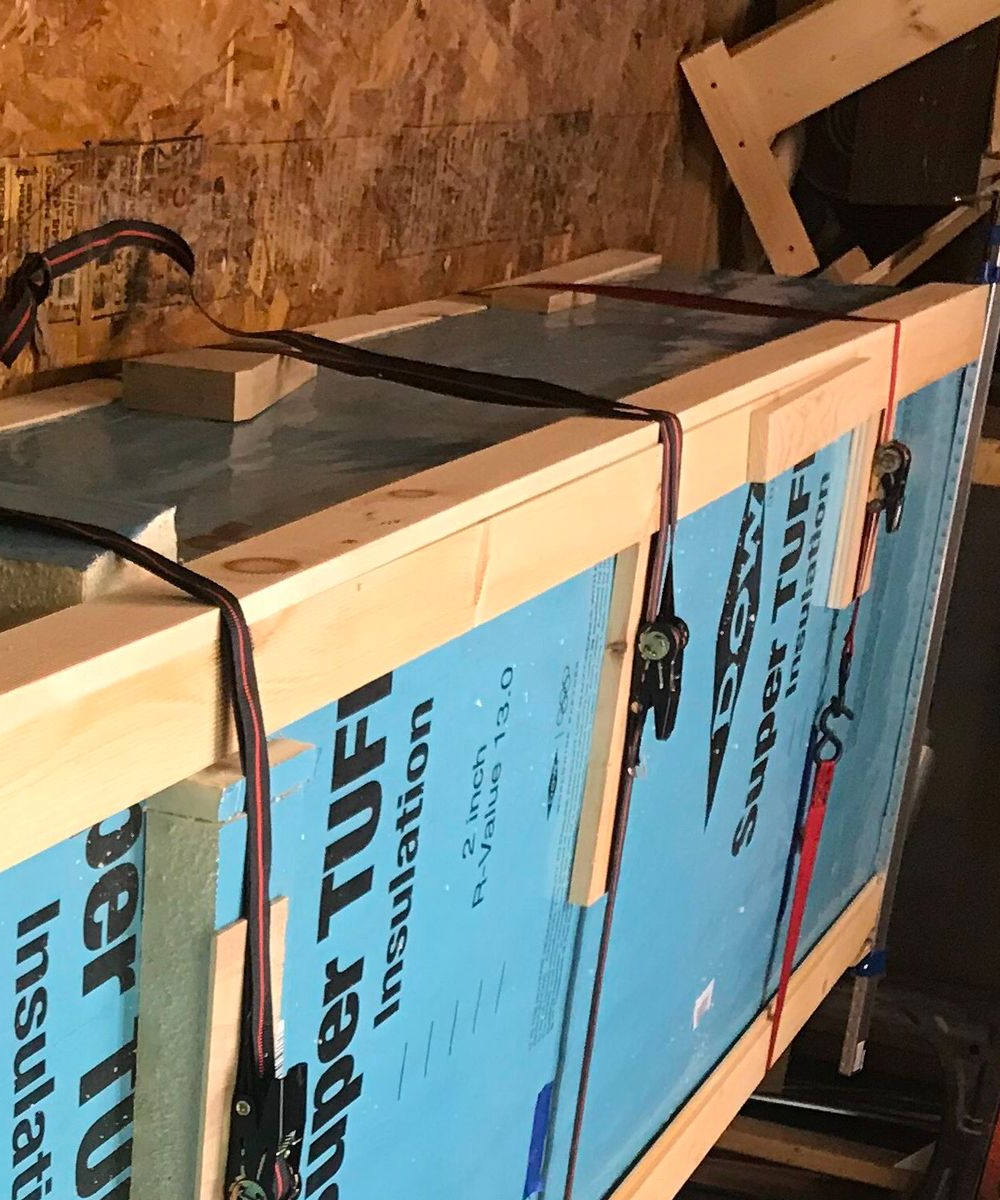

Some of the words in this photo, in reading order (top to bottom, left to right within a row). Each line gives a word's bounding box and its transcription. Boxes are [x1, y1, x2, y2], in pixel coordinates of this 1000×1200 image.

[711, 493, 764, 741] DOW
[785, 473, 830, 699] Insulation
[462, 833, 476, 860] 2
[465, 744, 488, 825] inch
[471, 762, 502, 909] R-Value
[493, 666, 514, 748] 13.0
[731, 639, 788, 858] Super
[373, 697, 434, 1029] Insulation
